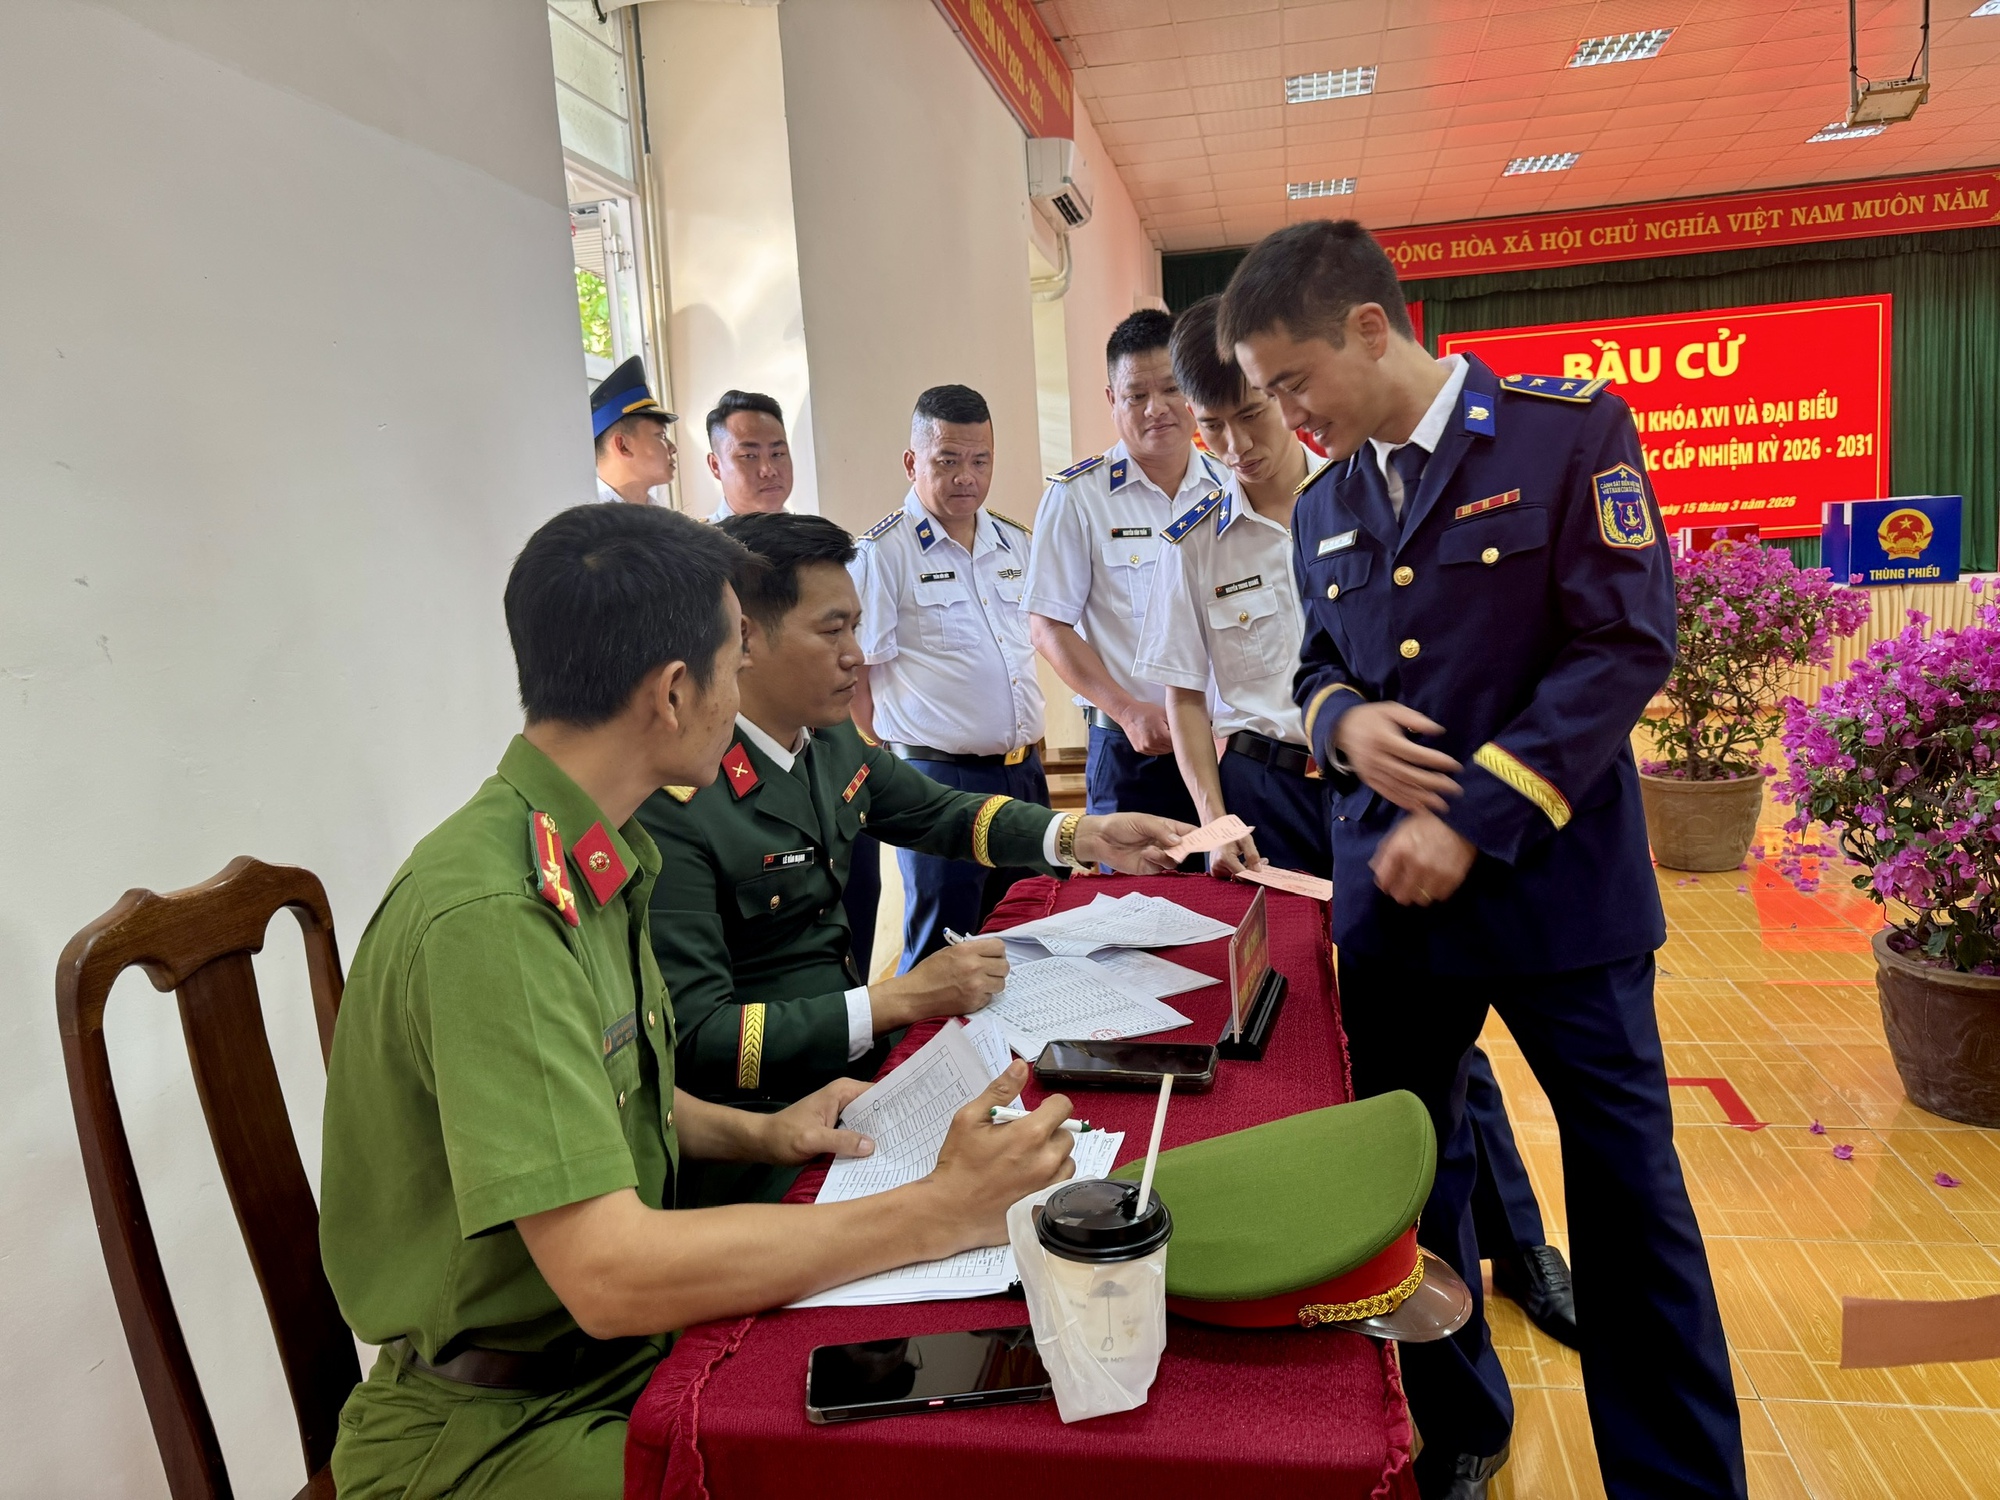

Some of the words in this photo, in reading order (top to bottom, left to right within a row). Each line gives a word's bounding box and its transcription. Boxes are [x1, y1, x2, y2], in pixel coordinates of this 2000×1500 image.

[1384, 241, 1444, 269] CỘNG
[1450, 234, 1496, 259] HÒA
[1502, 230, 1534, 254] XÃ
[1540, 226, 1583, 254] HỘI
[1589, 218, 1638, 246] CHỦ
[1727, 206, 1783, 236] VIỆT
[1790, 203, 1845, 226] NAM
[1851, 192, 1926, 220] MUÔN
[1932, 187, 1990, 212] NĂM
[1563, 338, 1661, 385] BẦU
[1675, 327, 1747, 380] CỬ
[1648, 403, 1698, 432] KHÓA
[1700, 406, 1730, 428] XVI
[1733, 397, 1759, 426] VÀ
[1762, 401, 1793, 428] ĐẠI
[1798, 388, 1838, 421] BIỂU
[1662, 439, 1696, 471] CẤP
[1698, 437, 1753, 471] NHIỆM
[1758, 433, 1780, 463] KỲ
[1782, 437, 1821, 462] 2026
[1836, 433, 1873, 458] 2031
[1682, 503, 1698, 514] 15
[1697, 501, 1729, 513] tháng
[1730, 500, 1739, 511] 3
[1740, 499, 1766, 510] năm
[1767, 496, 1797, 508] 2026
[1869, 566, 1905, 581] THÙNG
[1908, 564, 1940, 579] PHIẾU
